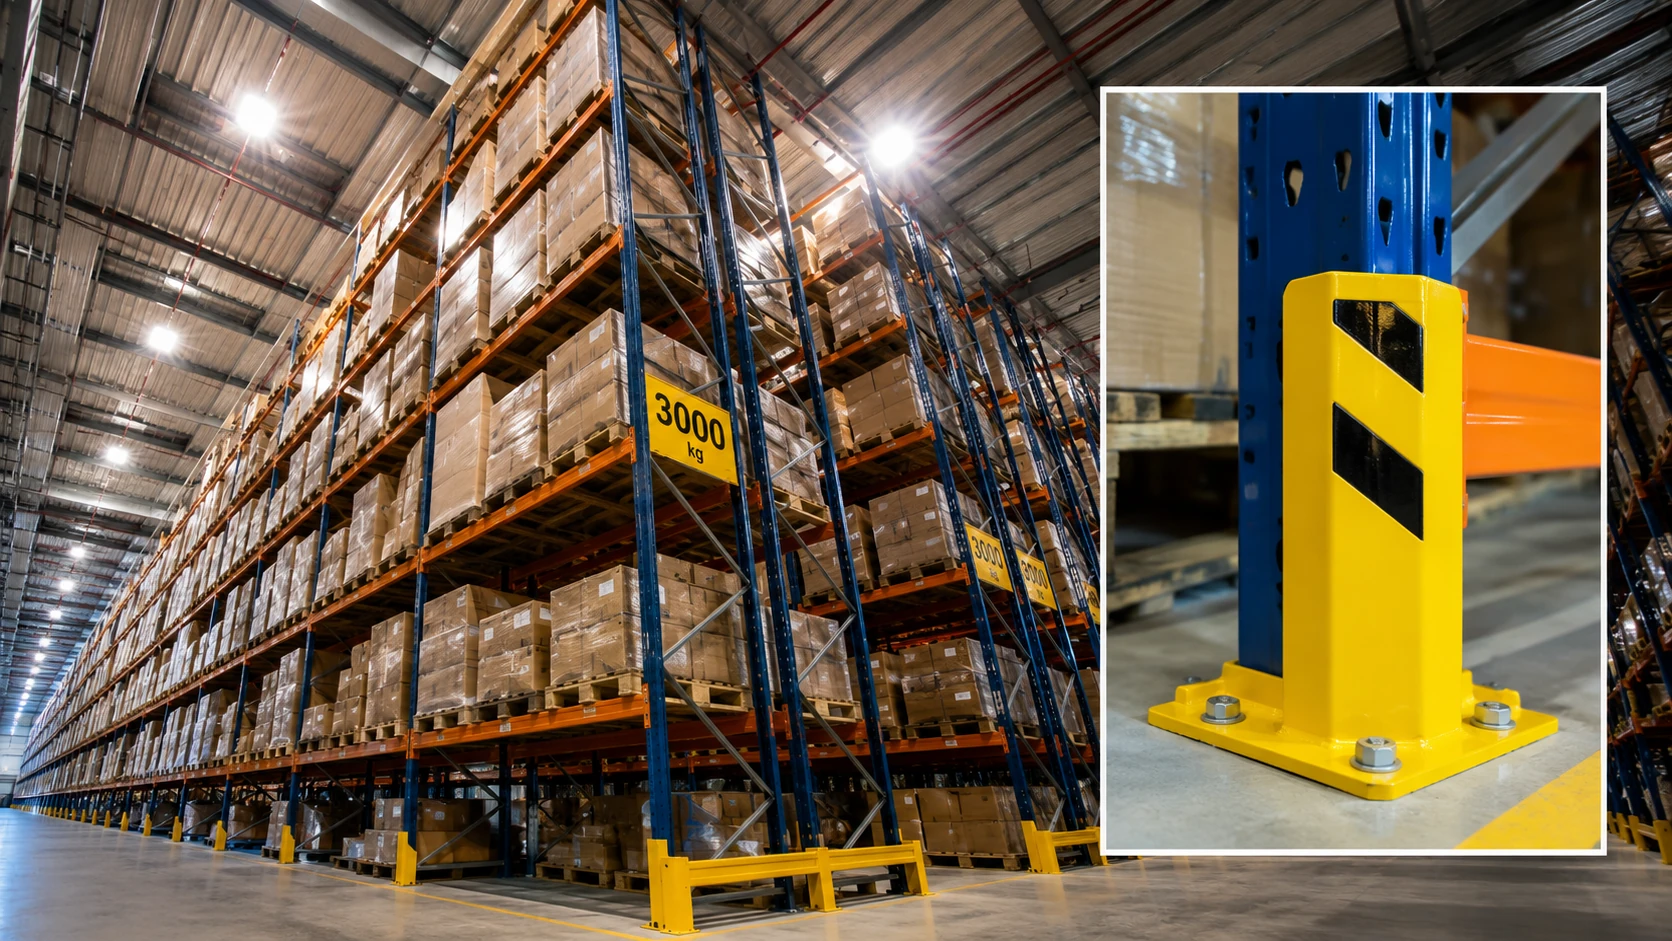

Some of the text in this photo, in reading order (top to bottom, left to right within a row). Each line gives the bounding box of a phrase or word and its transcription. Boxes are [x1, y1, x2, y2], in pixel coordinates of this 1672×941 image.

[655, 392, 725, 450] 3000
[687, 441, 704, 464] kg
[971, 535, 1003, 569] 3000
